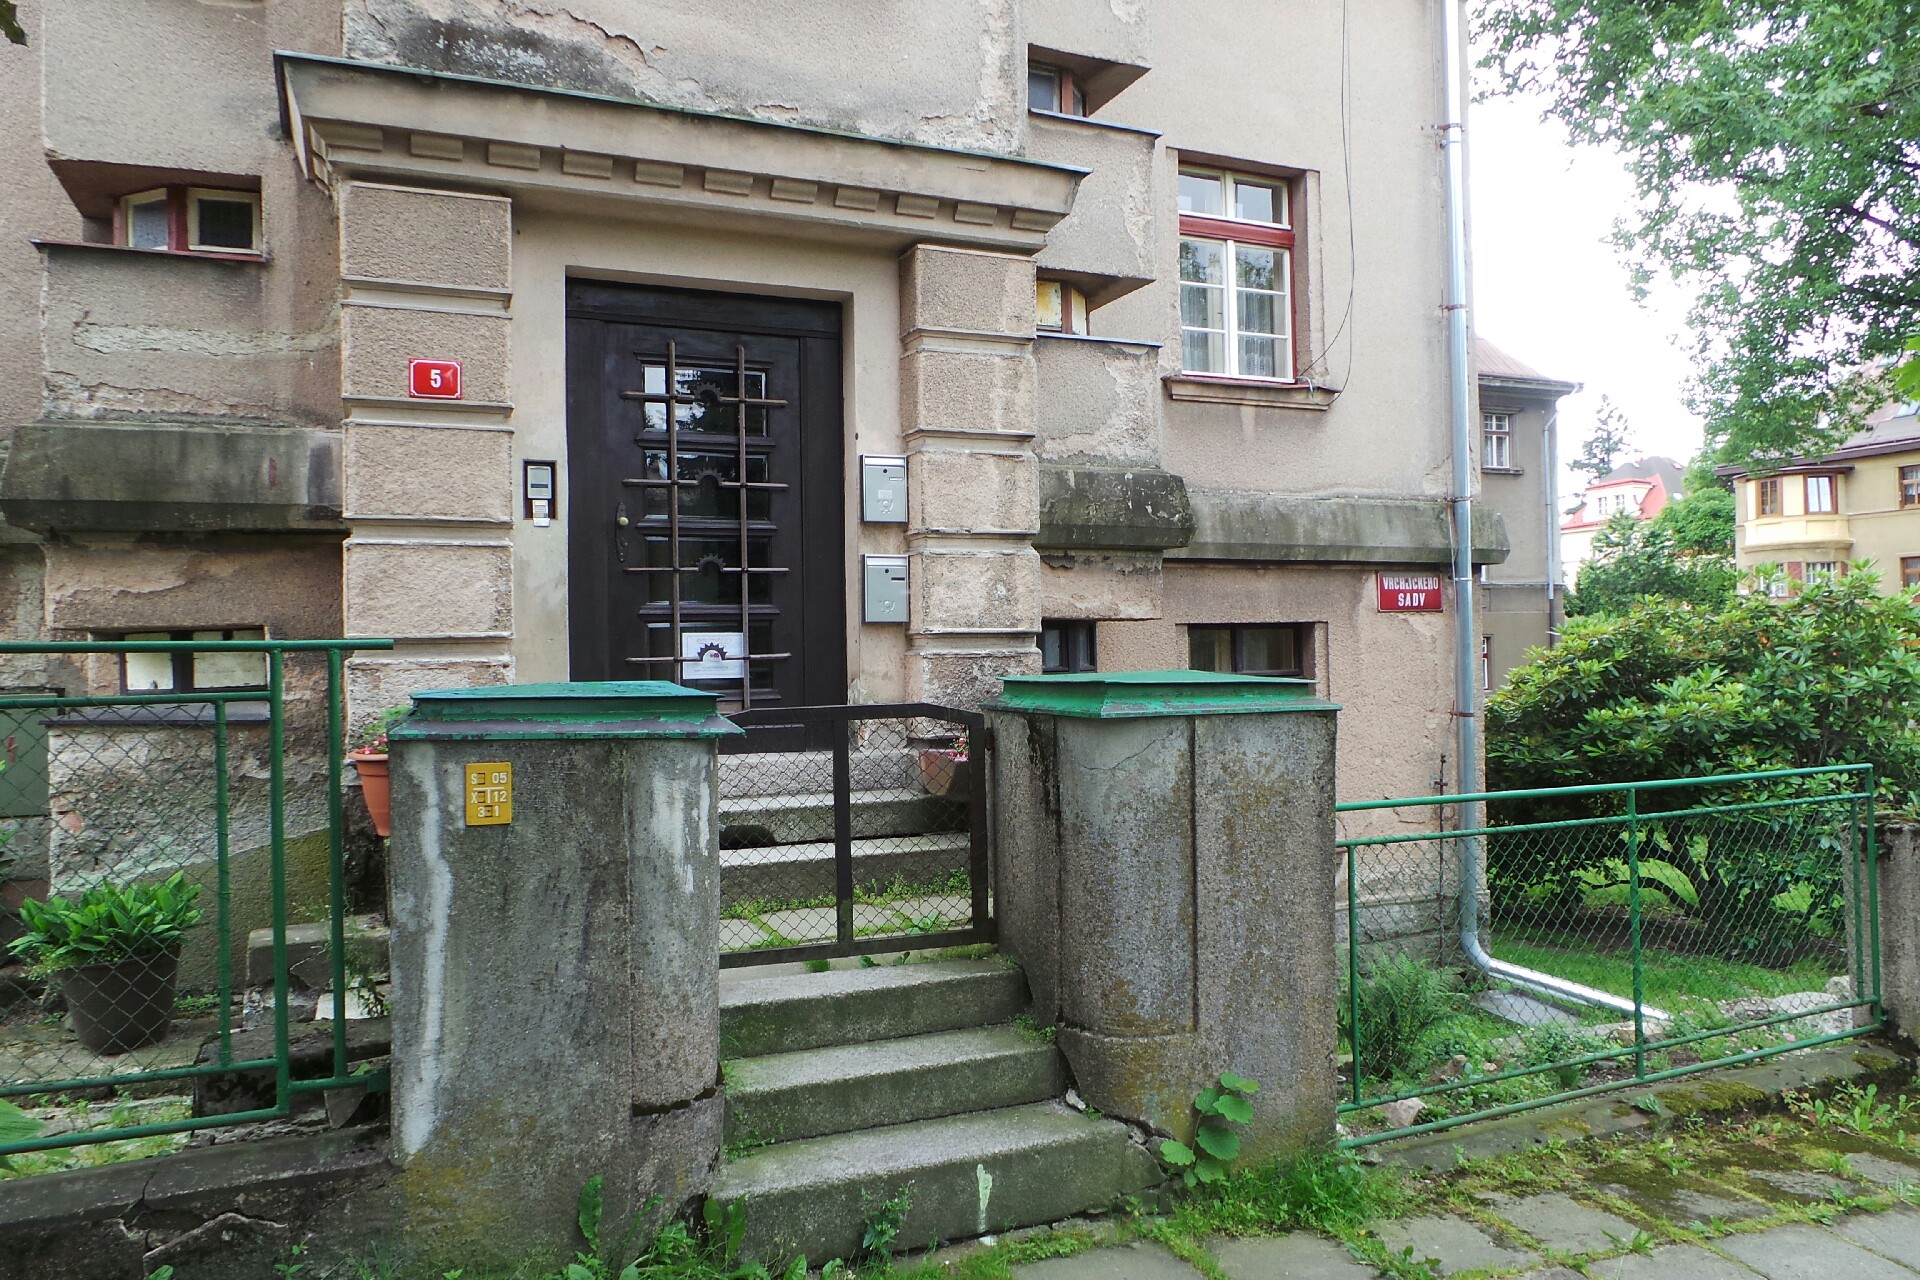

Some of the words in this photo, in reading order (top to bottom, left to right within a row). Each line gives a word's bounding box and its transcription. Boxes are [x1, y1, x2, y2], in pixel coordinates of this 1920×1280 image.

[430, 369, 442, 388] 5
[1397, 592, 1426, 607] SADY
[492, 772, 507, 784] 05
[493, 790, 507, 802] 12
